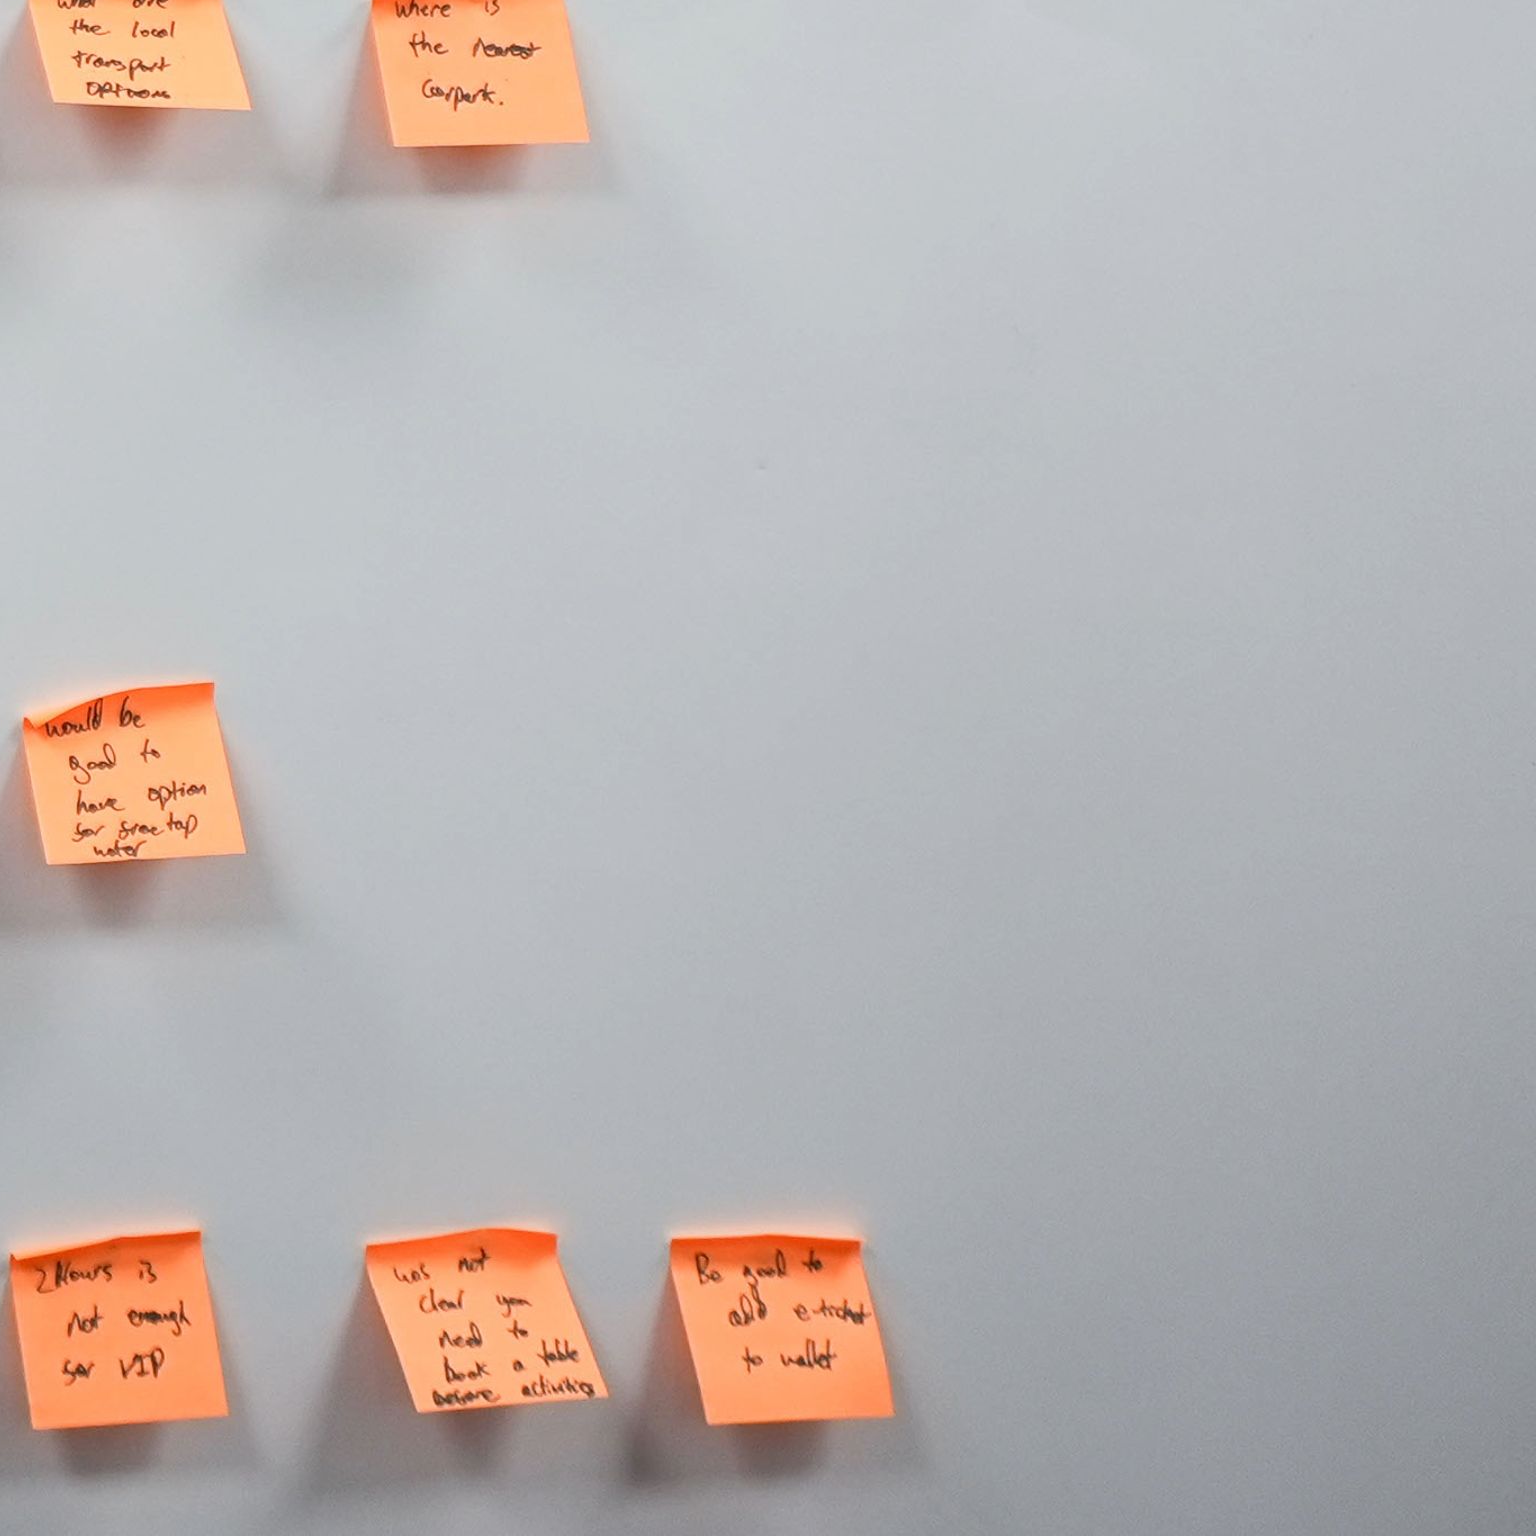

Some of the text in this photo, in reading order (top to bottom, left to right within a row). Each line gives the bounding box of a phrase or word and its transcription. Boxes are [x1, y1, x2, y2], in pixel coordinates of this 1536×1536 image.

[69, 19, 111, 35] the
[409, 31, 448, 58] the
[69, 739, 161, 784] good to
[76, 781, 207, 815] have option
[166, 812, 198, 839] tap
[802, 1250, 823, 1273] to
[507, 1320, 528, 1338] to
[120, 1347, 165, 1379] VIP
[513, 1360, 525, 1372] a
[742, 1347, 763, 1373] to
